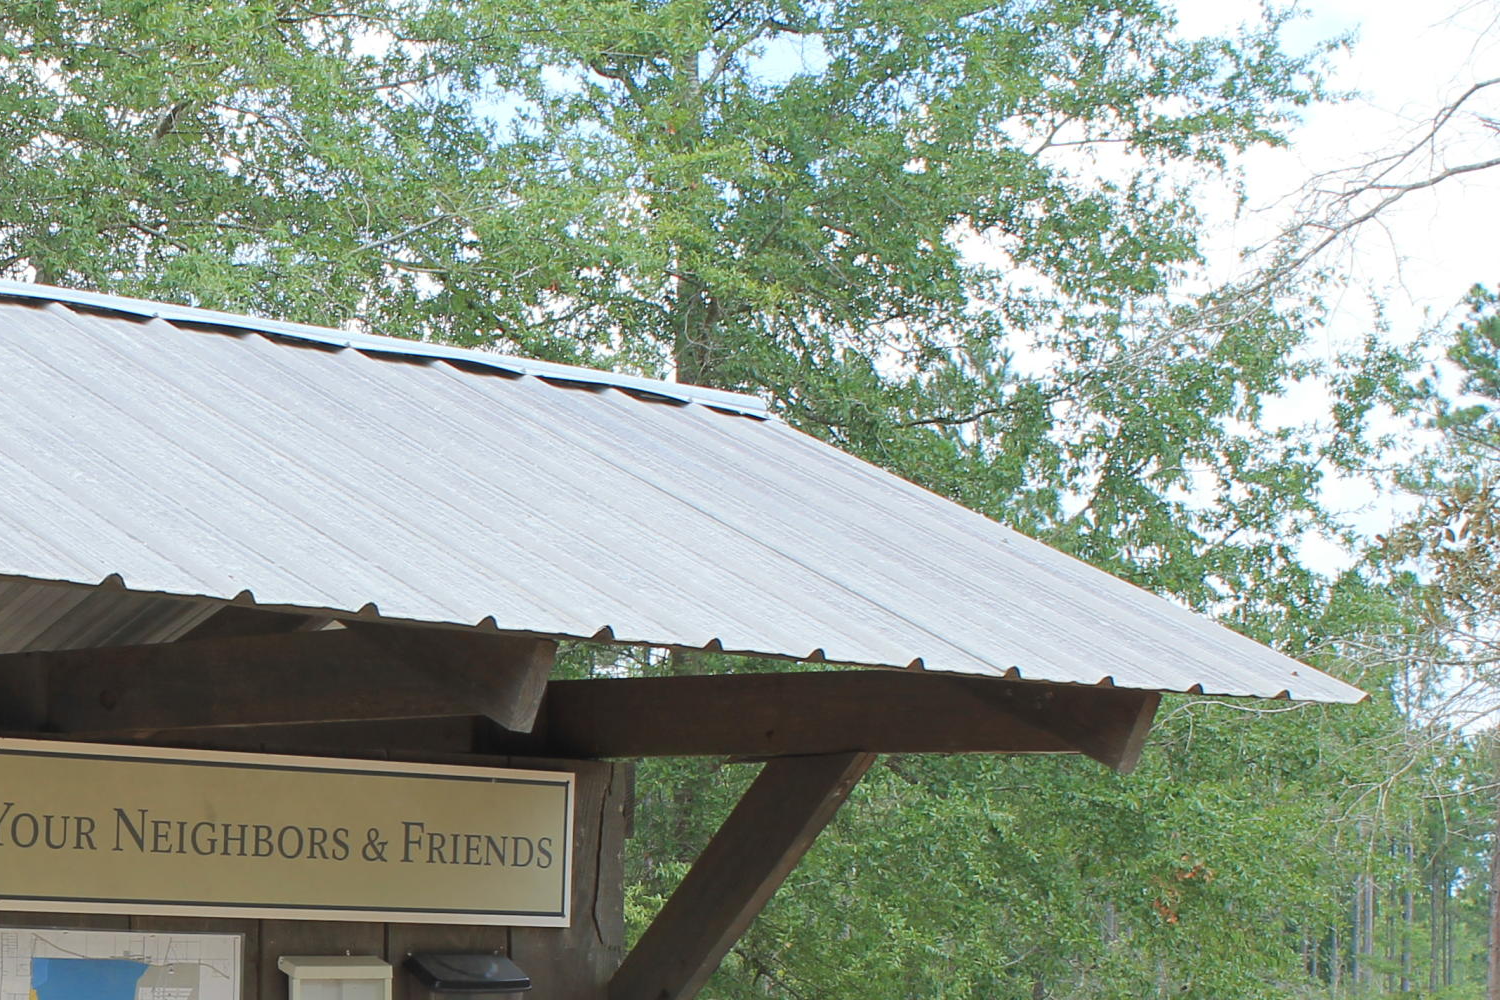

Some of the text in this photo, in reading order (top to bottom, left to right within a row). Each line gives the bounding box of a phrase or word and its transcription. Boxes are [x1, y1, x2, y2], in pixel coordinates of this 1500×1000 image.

[112, 808, 350, 862] NEIGHBORS
[361, 828, 388, 862] &
[401, 822, 553, 869] FRIENDS
